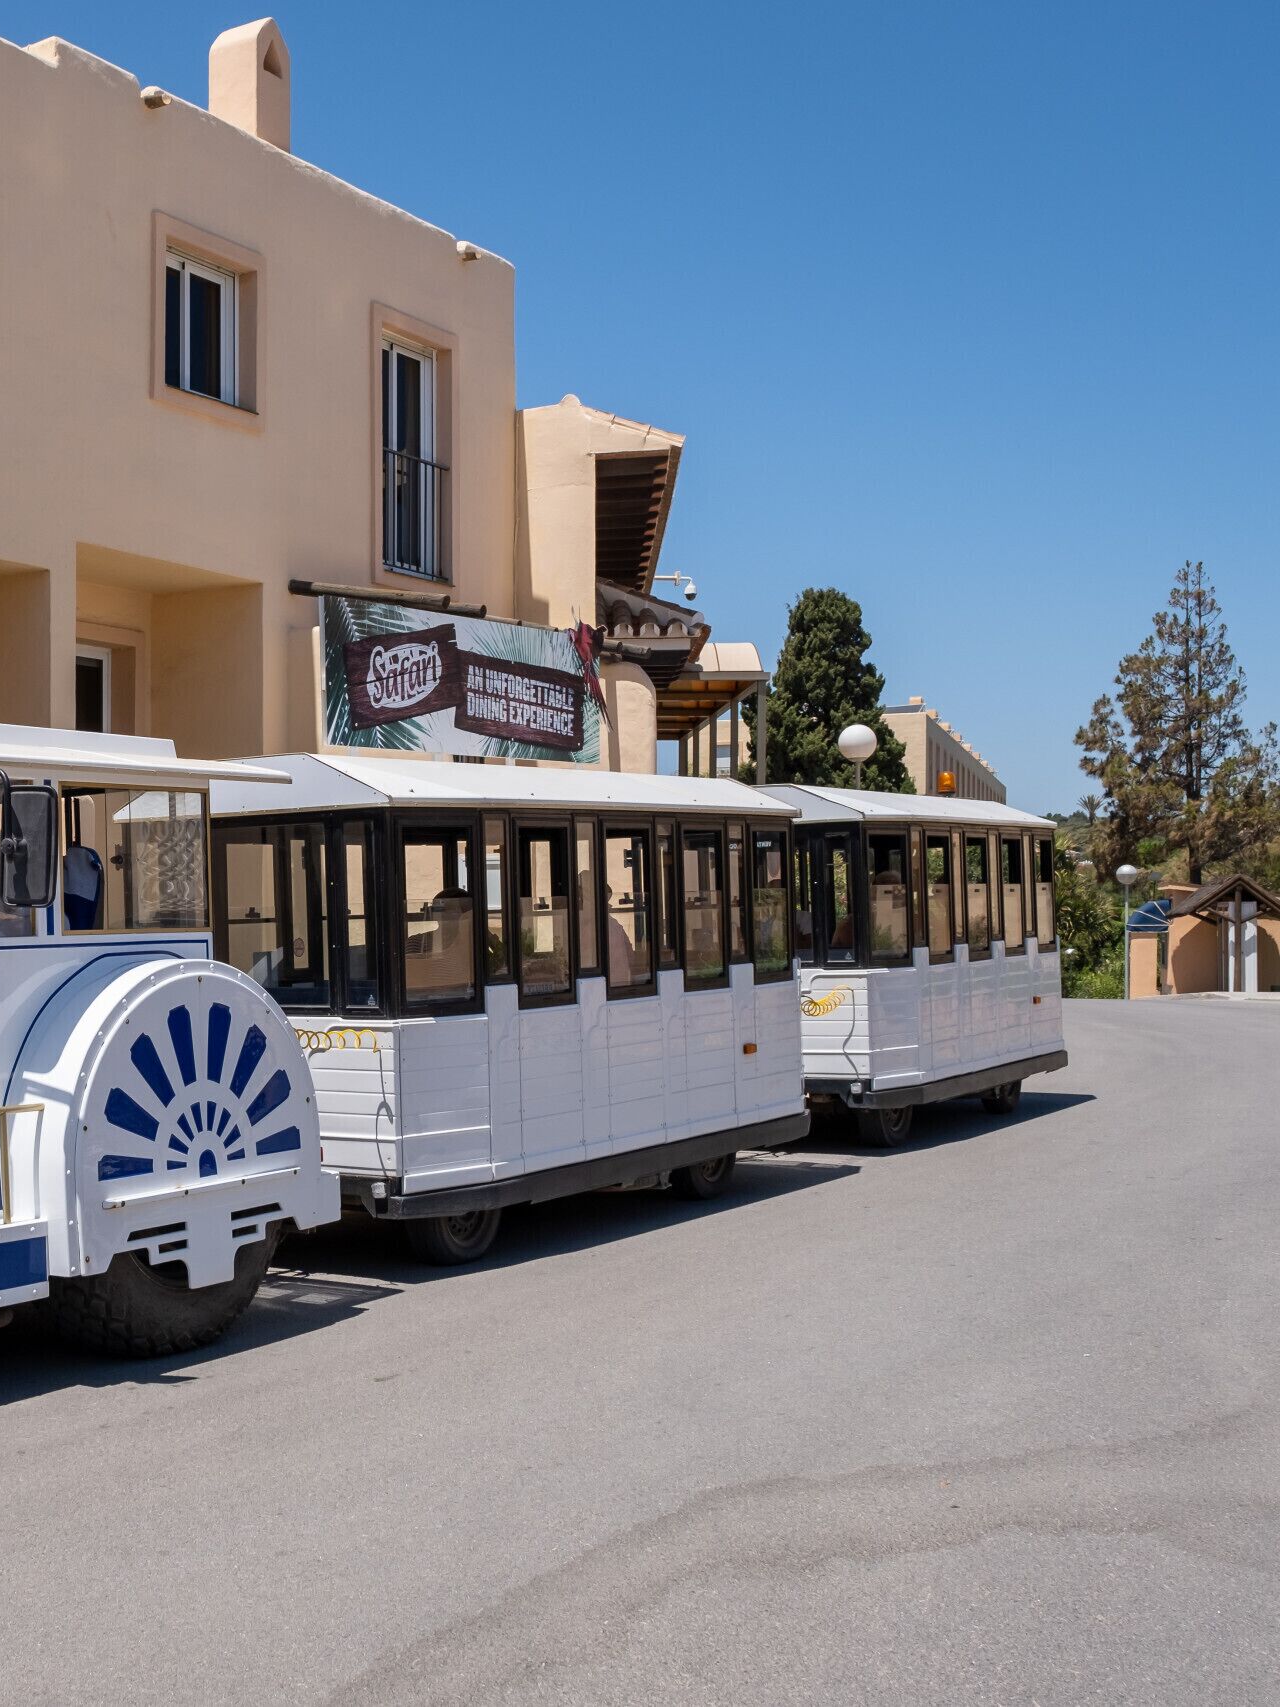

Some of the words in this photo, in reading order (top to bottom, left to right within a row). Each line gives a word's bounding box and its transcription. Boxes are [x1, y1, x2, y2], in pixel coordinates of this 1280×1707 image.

[370, 643, 439, 706] Safari
[467, 664, 484, 691] AN
[485, 668, 575, 711] UNFORGETTABLE
[467, 692, 507, 722] DINING
[509, 700, 574, 736] EXPERIENCE
